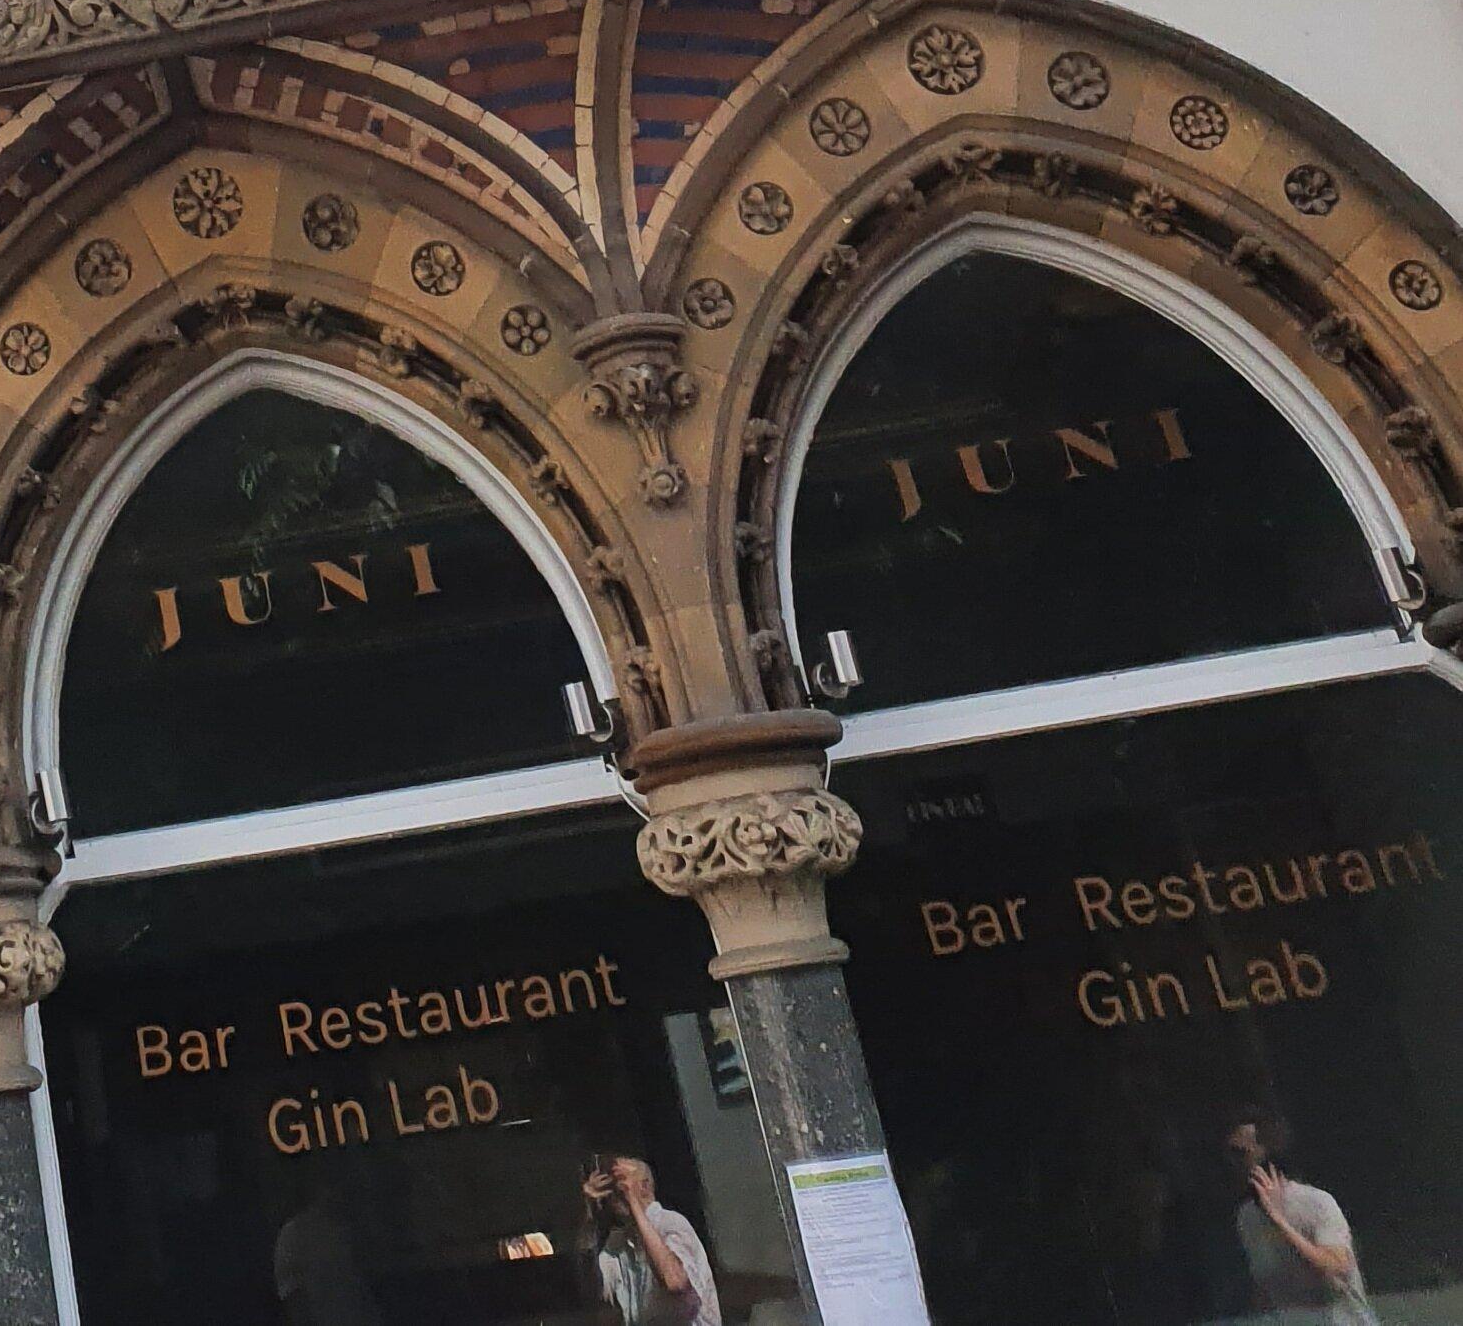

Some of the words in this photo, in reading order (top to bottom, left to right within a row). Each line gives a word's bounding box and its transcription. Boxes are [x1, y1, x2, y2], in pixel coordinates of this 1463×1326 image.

[887, 408, 1194, 523] JUNI
[151, 543, 442, 652] JUNI
[920, 892, 1028, 958] Bar
[1074, 831, 1445, 931] Restaurant
[137, 1024, 236, 1078] Bar
[279, 954, 628, 1056] Restaurant
[1077, 959, 1191, 1029] Gin
[1205, 940, 1330, 1012] Lab
[268, 1089, 369, 1154] Gin
[390, 1065, 500, 1137] Lab
